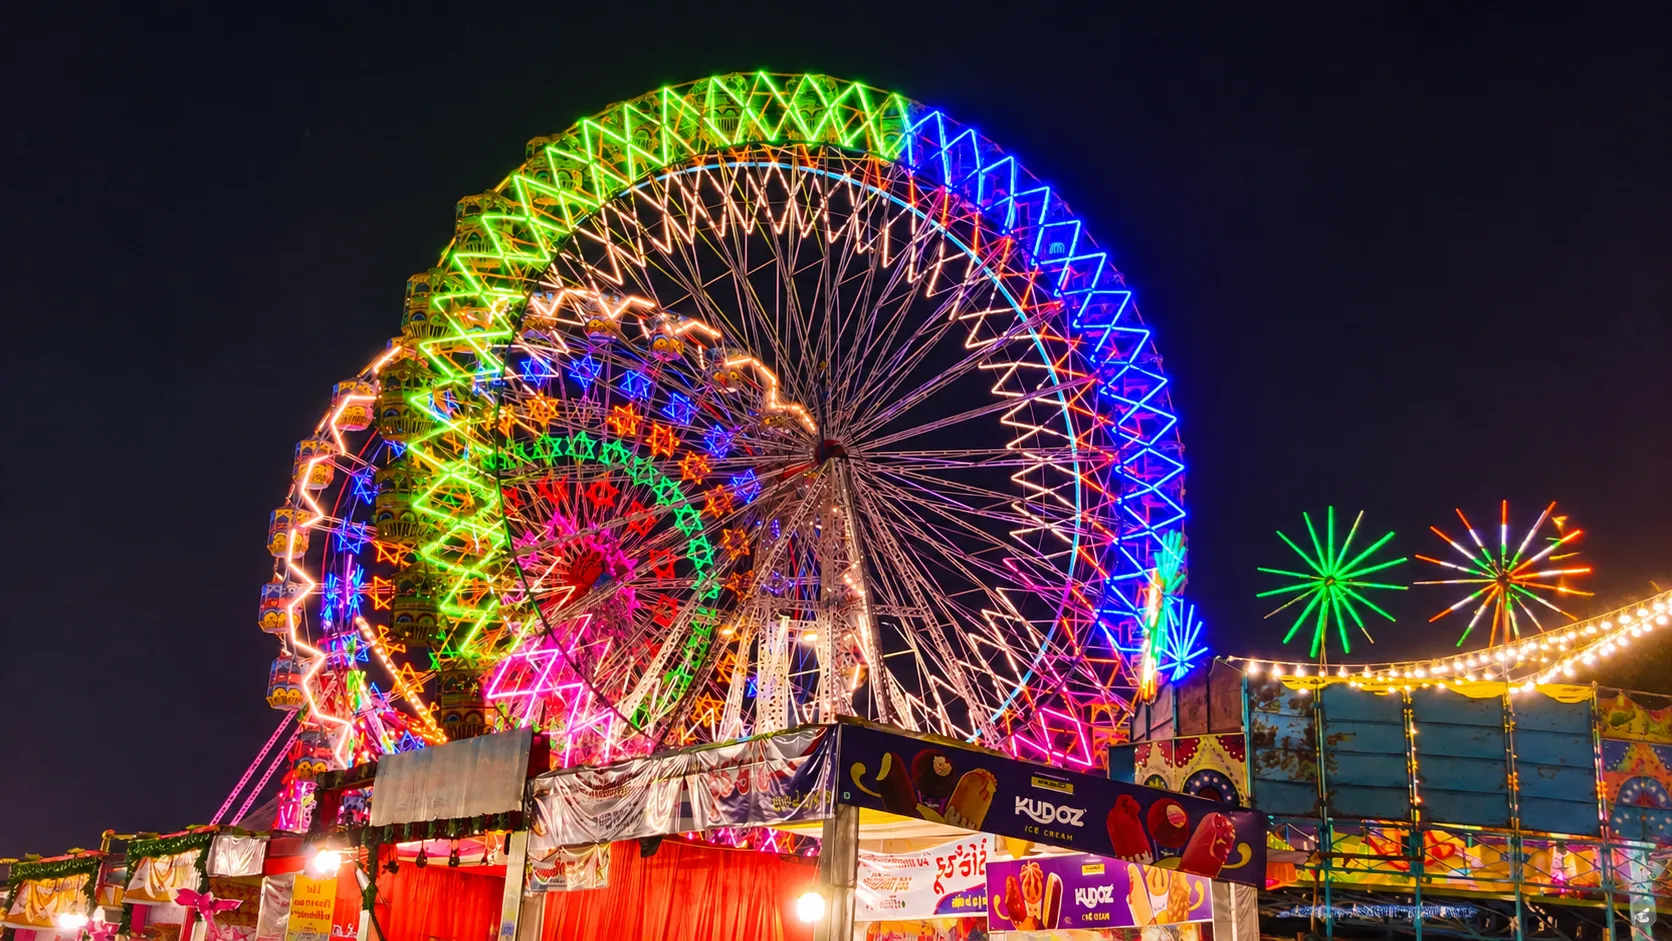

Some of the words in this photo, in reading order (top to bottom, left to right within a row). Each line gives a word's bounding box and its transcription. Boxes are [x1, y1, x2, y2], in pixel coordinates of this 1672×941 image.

[1015, 796, 1086, 827] KUDOZ
[1024, 825, 1040, 835] ICE
[1043, 829, 1073, 841] CREAM
[1075, 884, 1114, 909] KUDOZ
